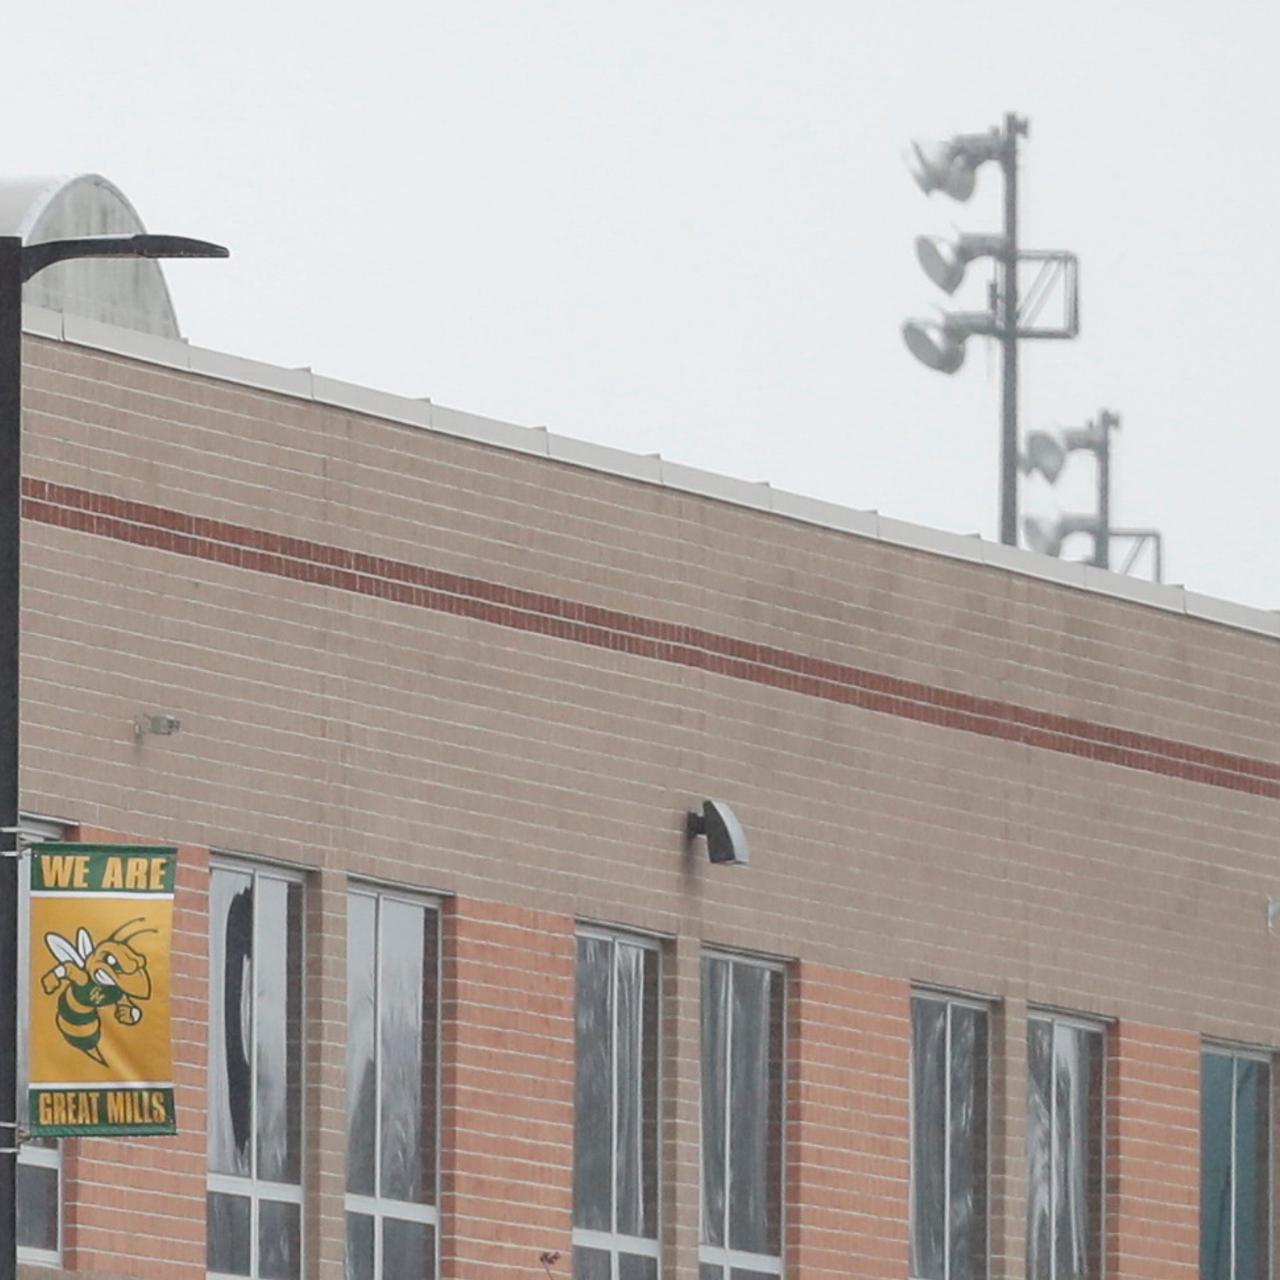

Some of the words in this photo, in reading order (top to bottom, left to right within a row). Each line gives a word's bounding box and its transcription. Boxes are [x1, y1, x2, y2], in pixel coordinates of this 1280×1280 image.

[41, 855, 90, 888] WE
[101, 856, 167, 890] ARE
[40, 1092, 100, 1126] GREAT
[106, 1091, 166, 1126] MILLS
